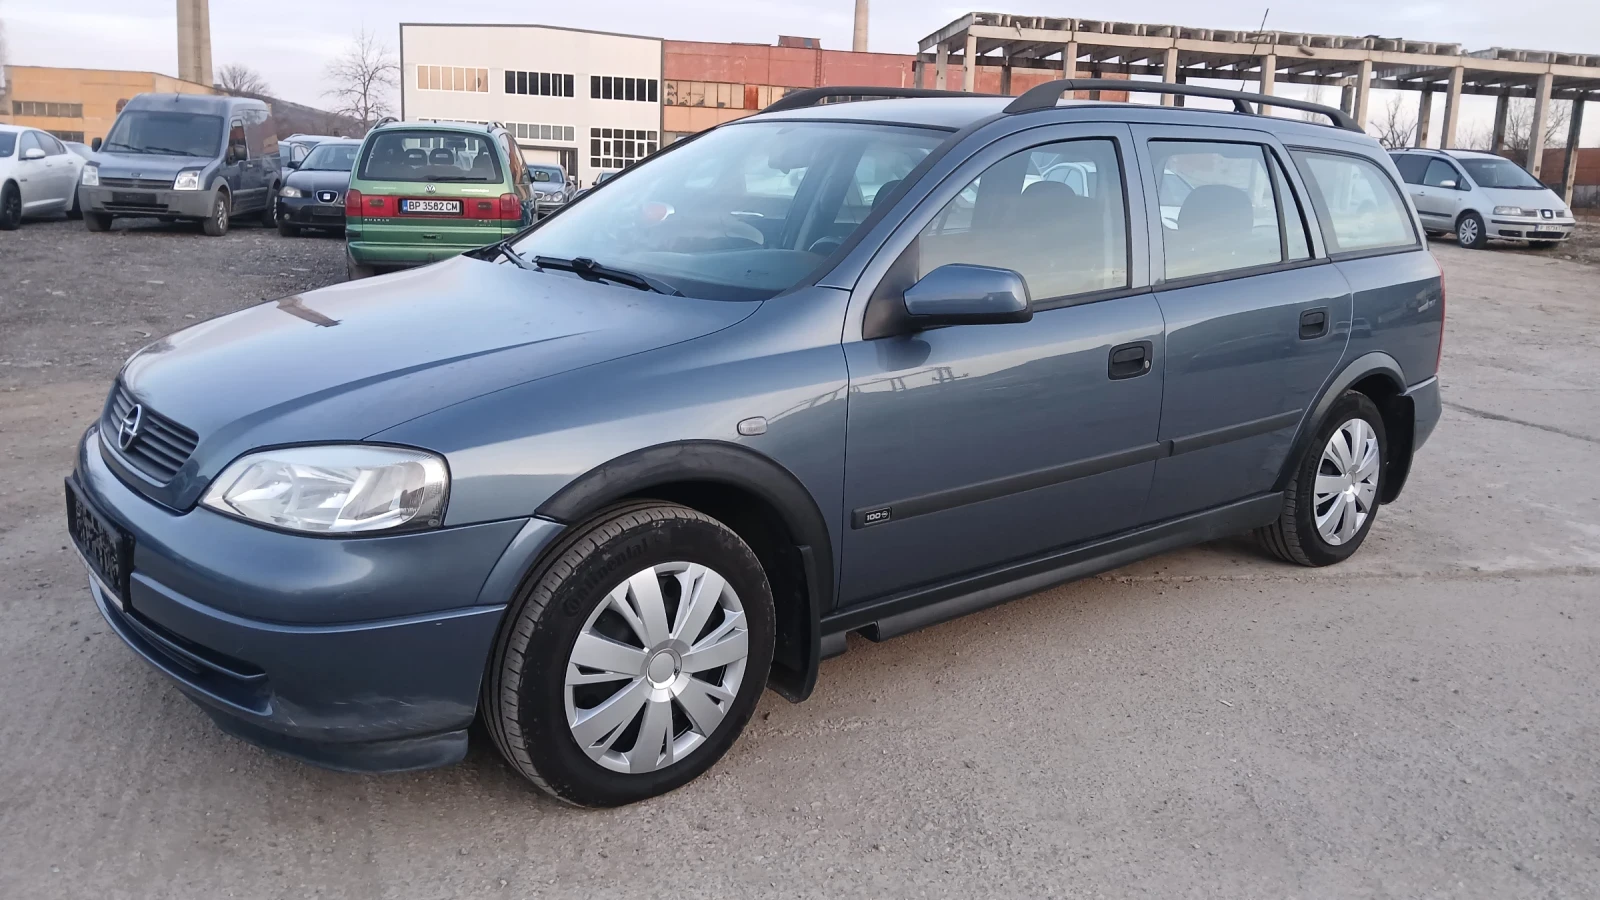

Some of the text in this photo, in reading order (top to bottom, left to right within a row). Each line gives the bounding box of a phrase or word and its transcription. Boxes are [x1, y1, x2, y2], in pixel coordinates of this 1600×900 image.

[408, 201, 458, 211] BP 3582 CM
[866, 512, 881, 521] 100
[561, 537, 649, 618] Continental
